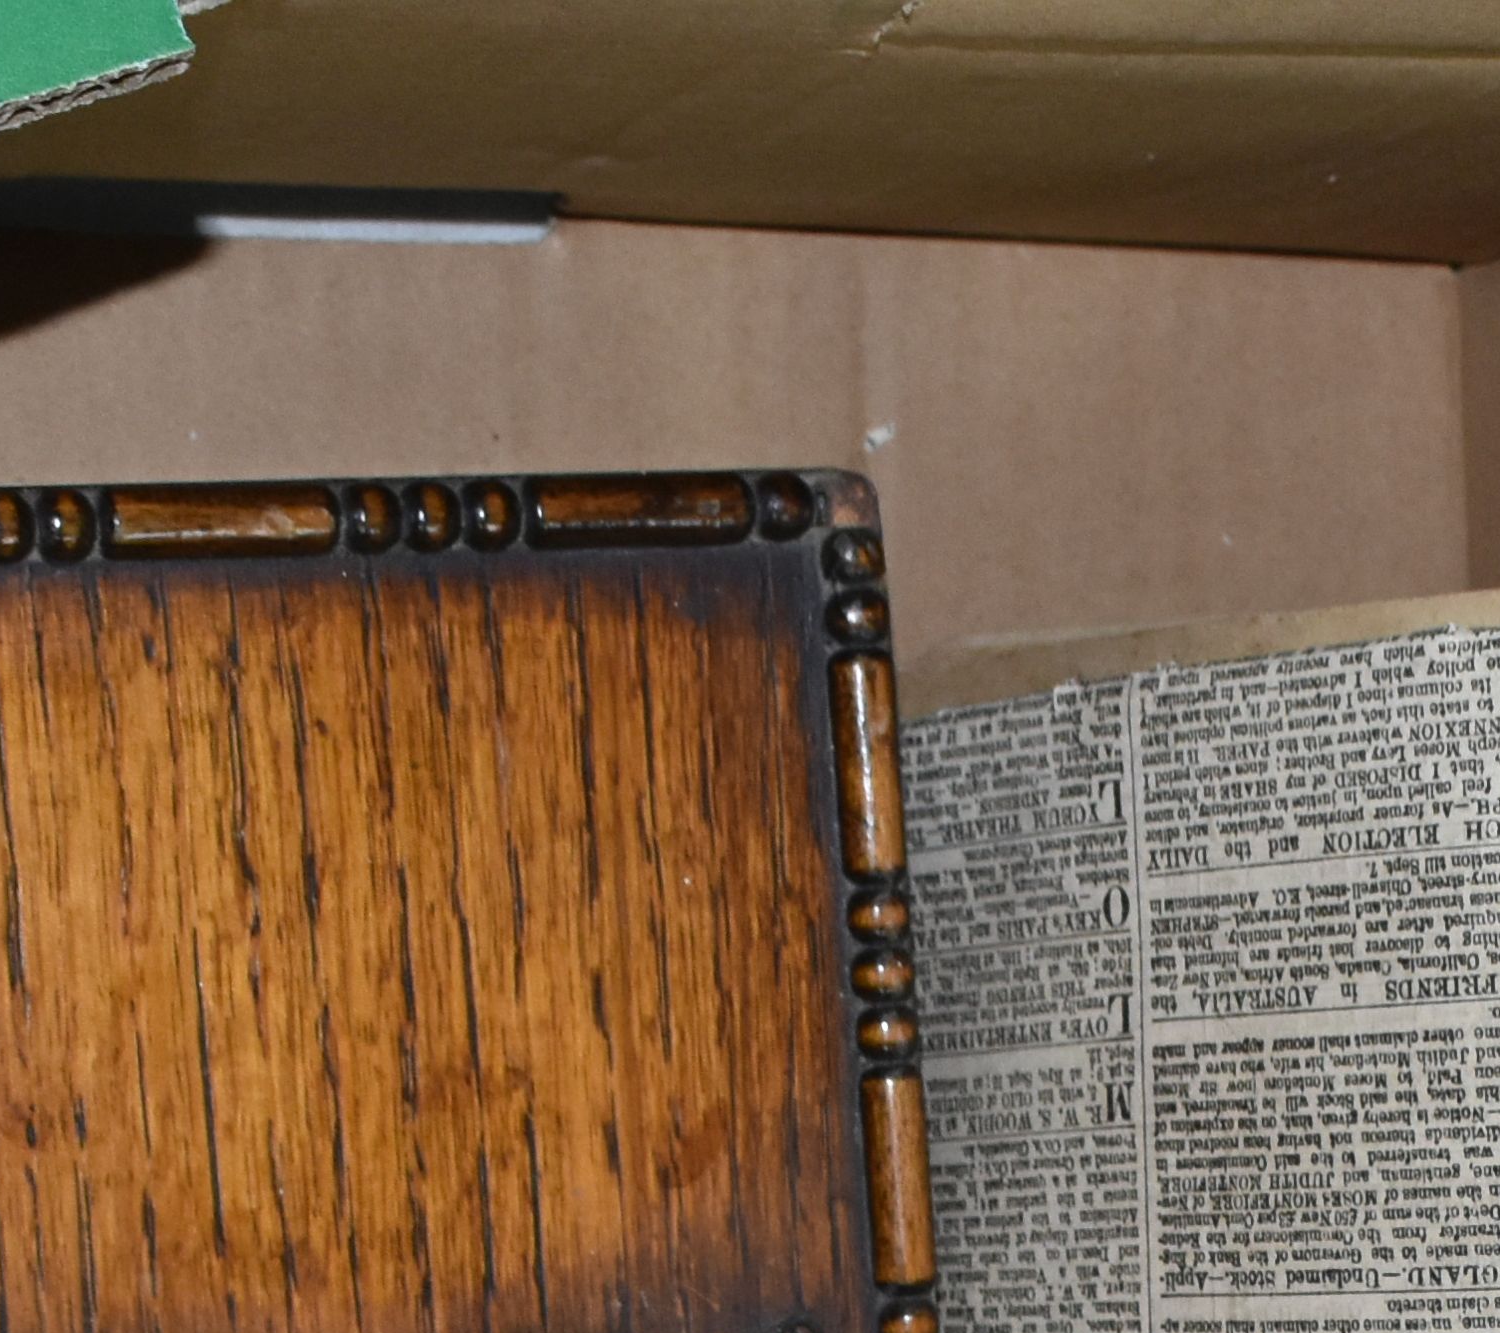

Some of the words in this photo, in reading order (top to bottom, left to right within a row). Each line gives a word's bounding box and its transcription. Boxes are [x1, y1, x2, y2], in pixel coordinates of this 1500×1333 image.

[1267, 836, 1299, 857] and
[1322, 823, 1440, 853] ELECTION
[1146, 847, 1209, 870] DAILY
[1224, 840, 1251, 861] the
[1340, 981, 1358, 1001] in
[1383, 972, 1498, 1001] FRIENDS
[1151, 994, 1177, 1015] the
[1193, 985, 1318, 1012] AUSTRALIA,
